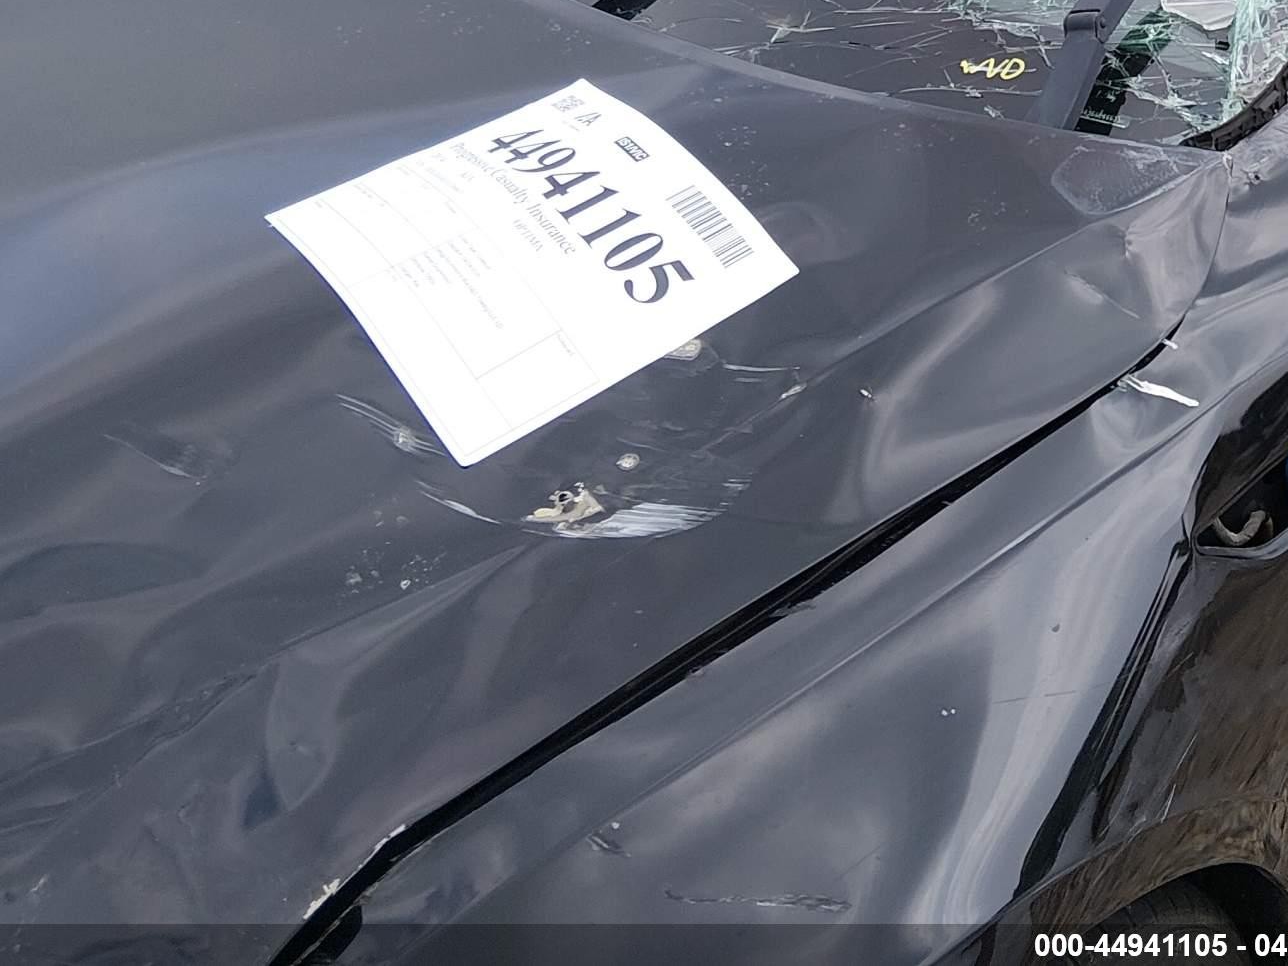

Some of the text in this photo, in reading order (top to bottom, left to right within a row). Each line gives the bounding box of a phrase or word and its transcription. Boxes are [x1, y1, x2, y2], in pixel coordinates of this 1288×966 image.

[487, 128, 696, 305] 44941105
[490, 169, 529, 205] Casualty
[526, 203, 577, 255] Insurance
